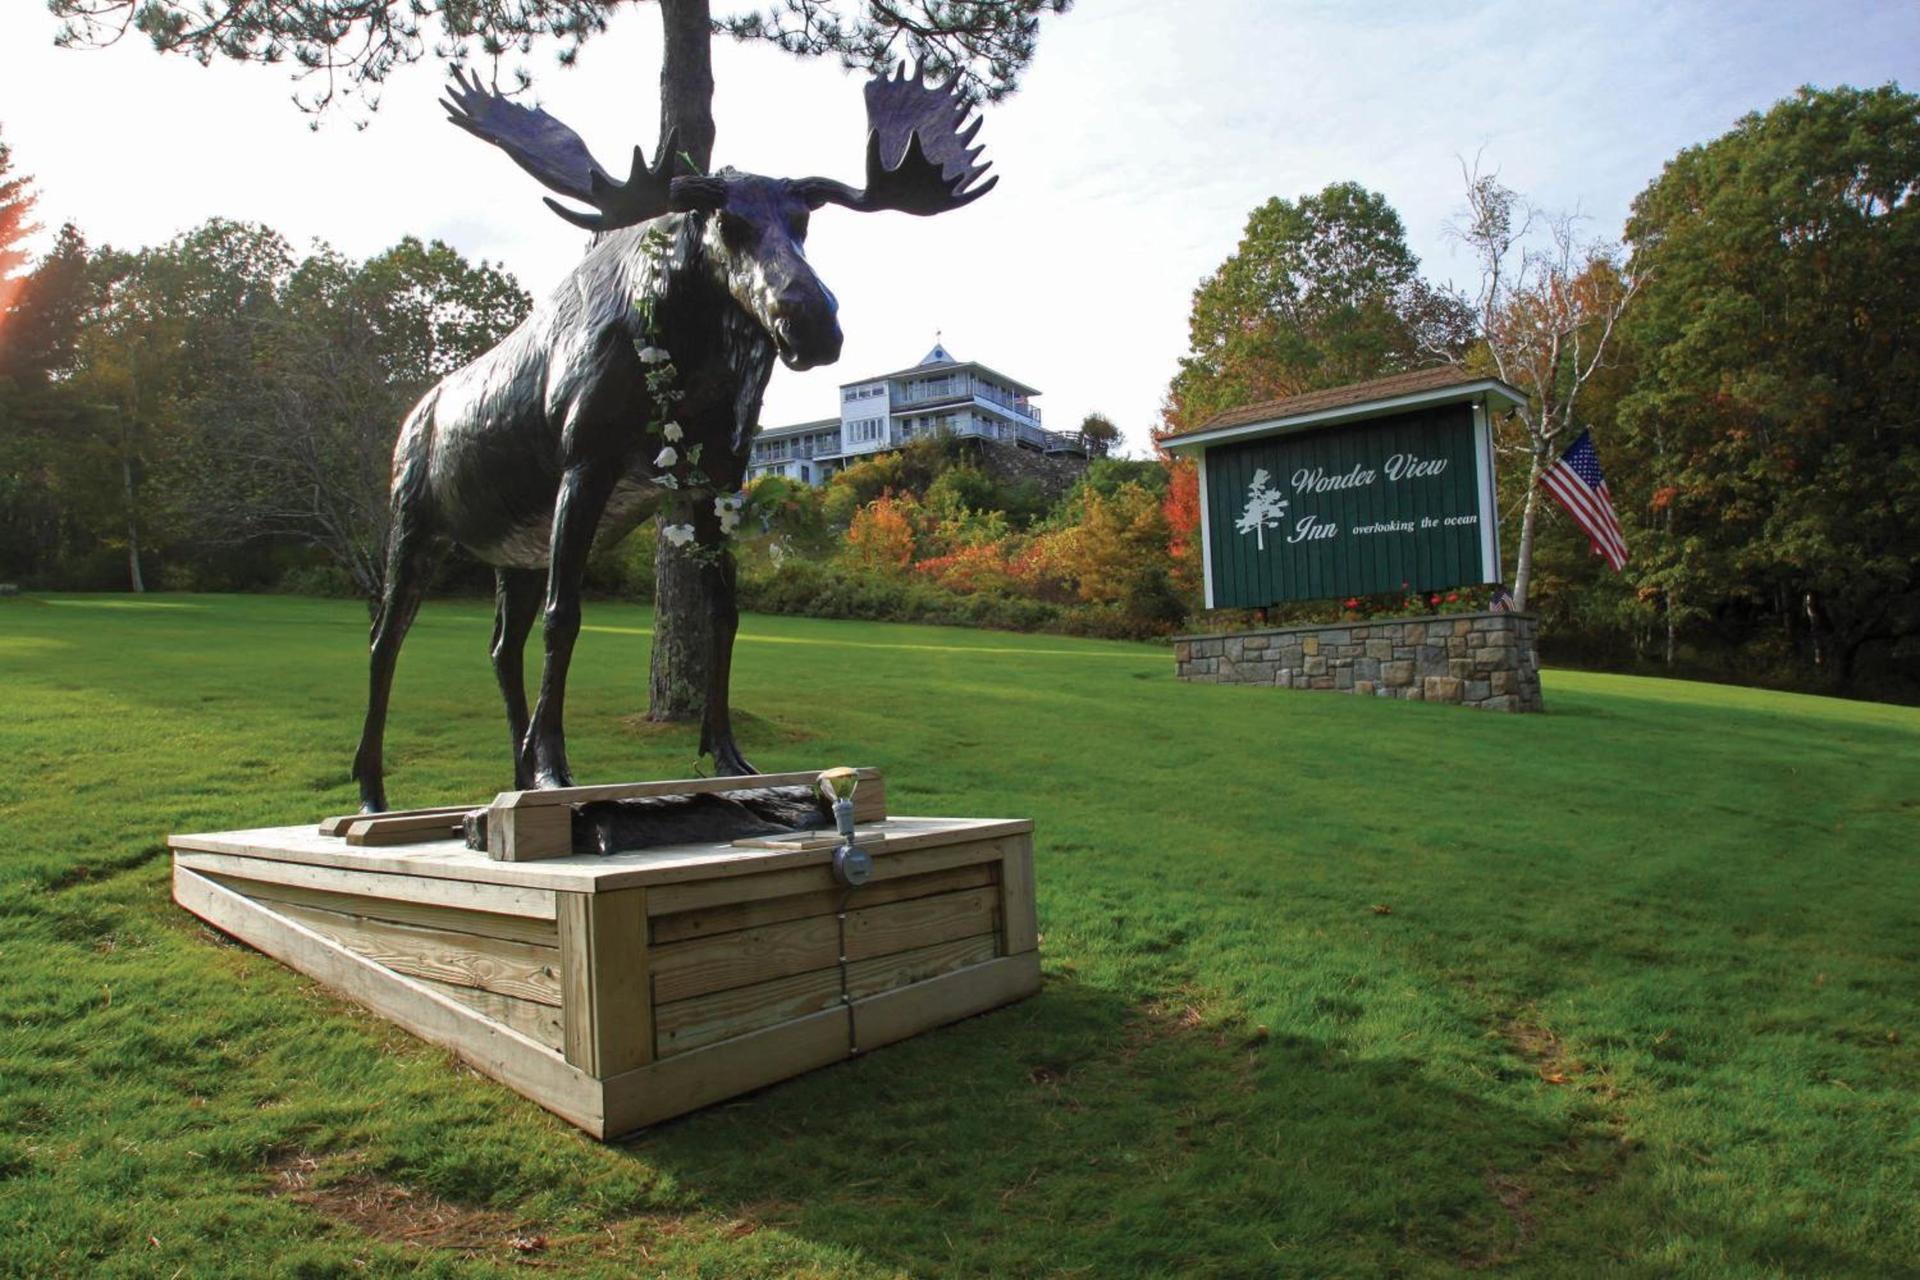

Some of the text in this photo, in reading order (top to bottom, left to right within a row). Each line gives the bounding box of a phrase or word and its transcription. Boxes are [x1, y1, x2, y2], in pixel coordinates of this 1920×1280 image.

[1291, 454, 1448, 494] Wonder View
[1287, 515, 1338, 543] Inn
[1353, 515, 1477, 535] overlooking the ocean
